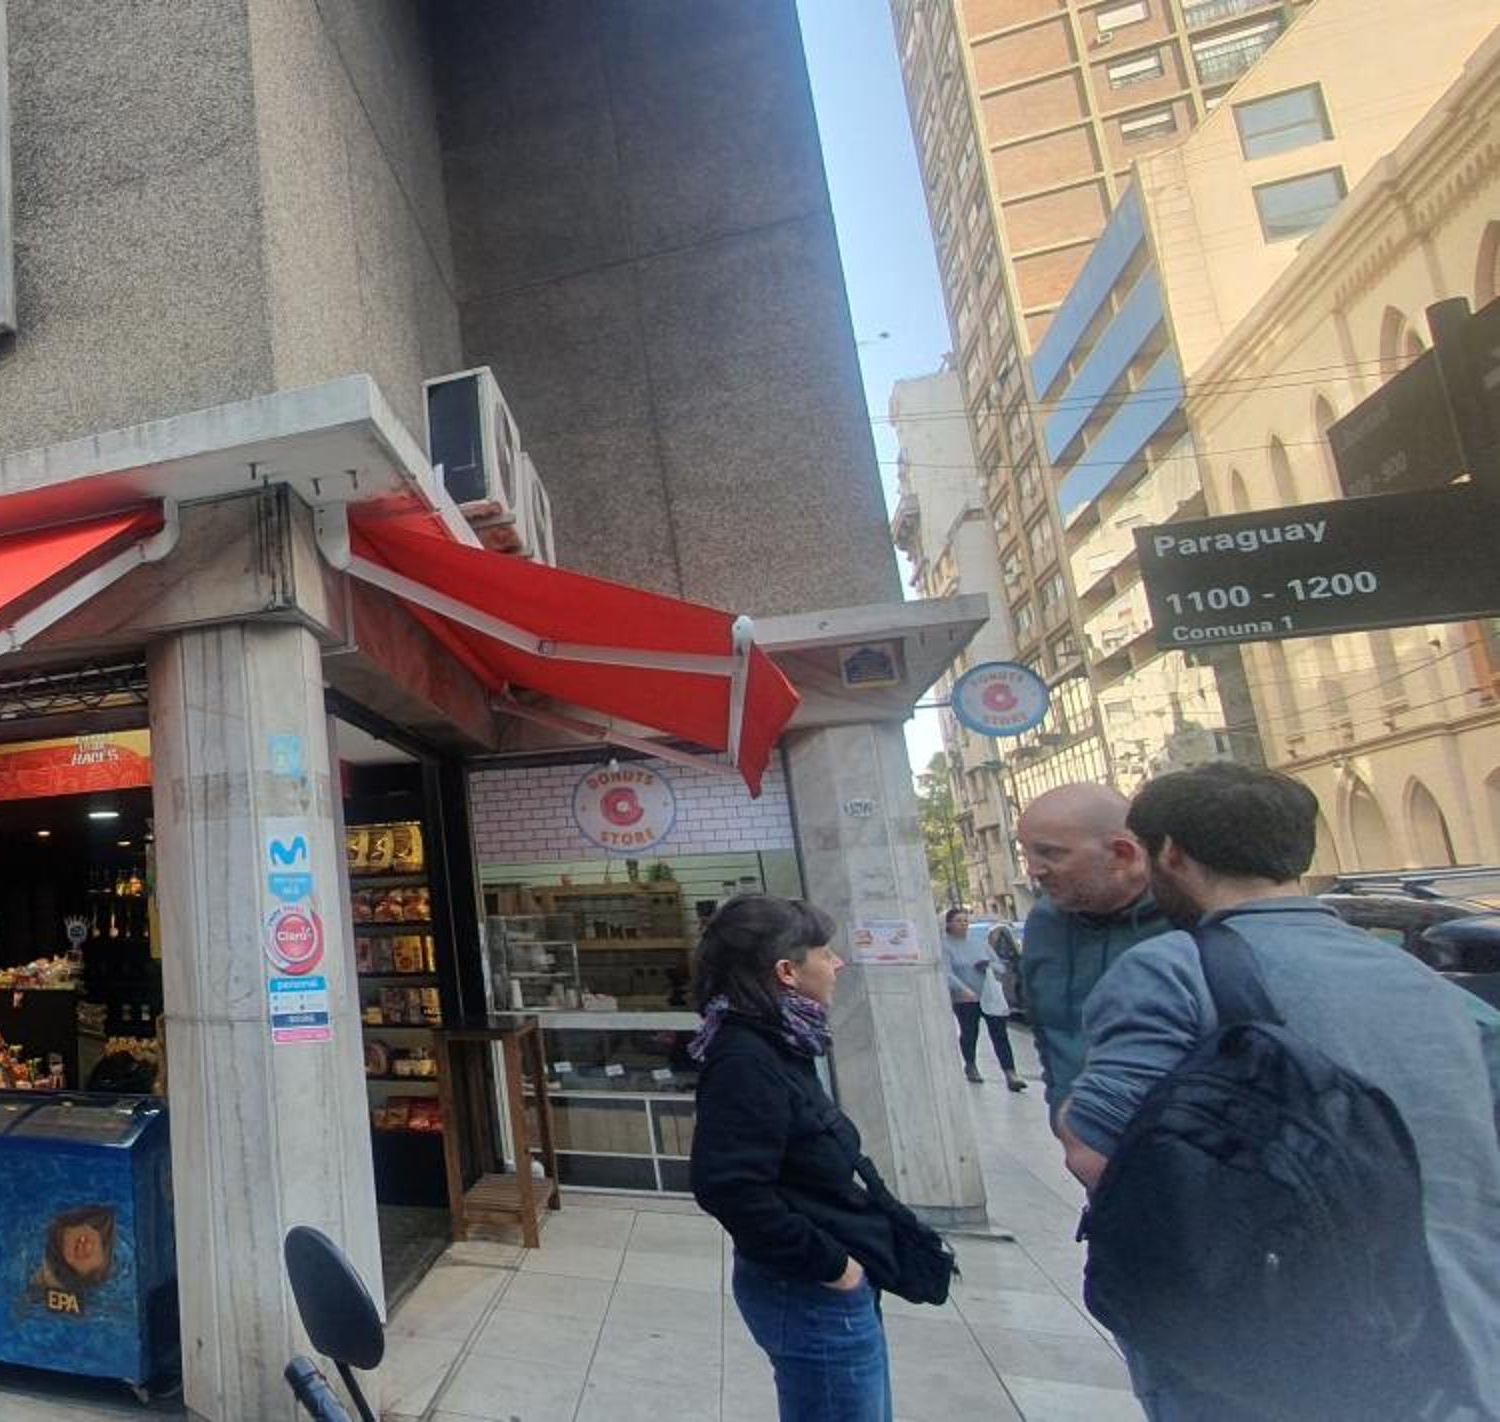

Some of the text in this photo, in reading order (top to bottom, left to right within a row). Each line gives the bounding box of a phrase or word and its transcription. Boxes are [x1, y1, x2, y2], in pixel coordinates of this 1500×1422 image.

[1154, 520, 1326, 557] Paraguay
[1166, 585, 1250, 614] 1100
[1287, 571, 1377, 600] 1200
[1172, 616, 1293, 641] Comuna 1
[586, 770, 654, 789] DONUTS
[601, 828, 654, 845] STORE
[47, 1289, 80, 1313] EPA
